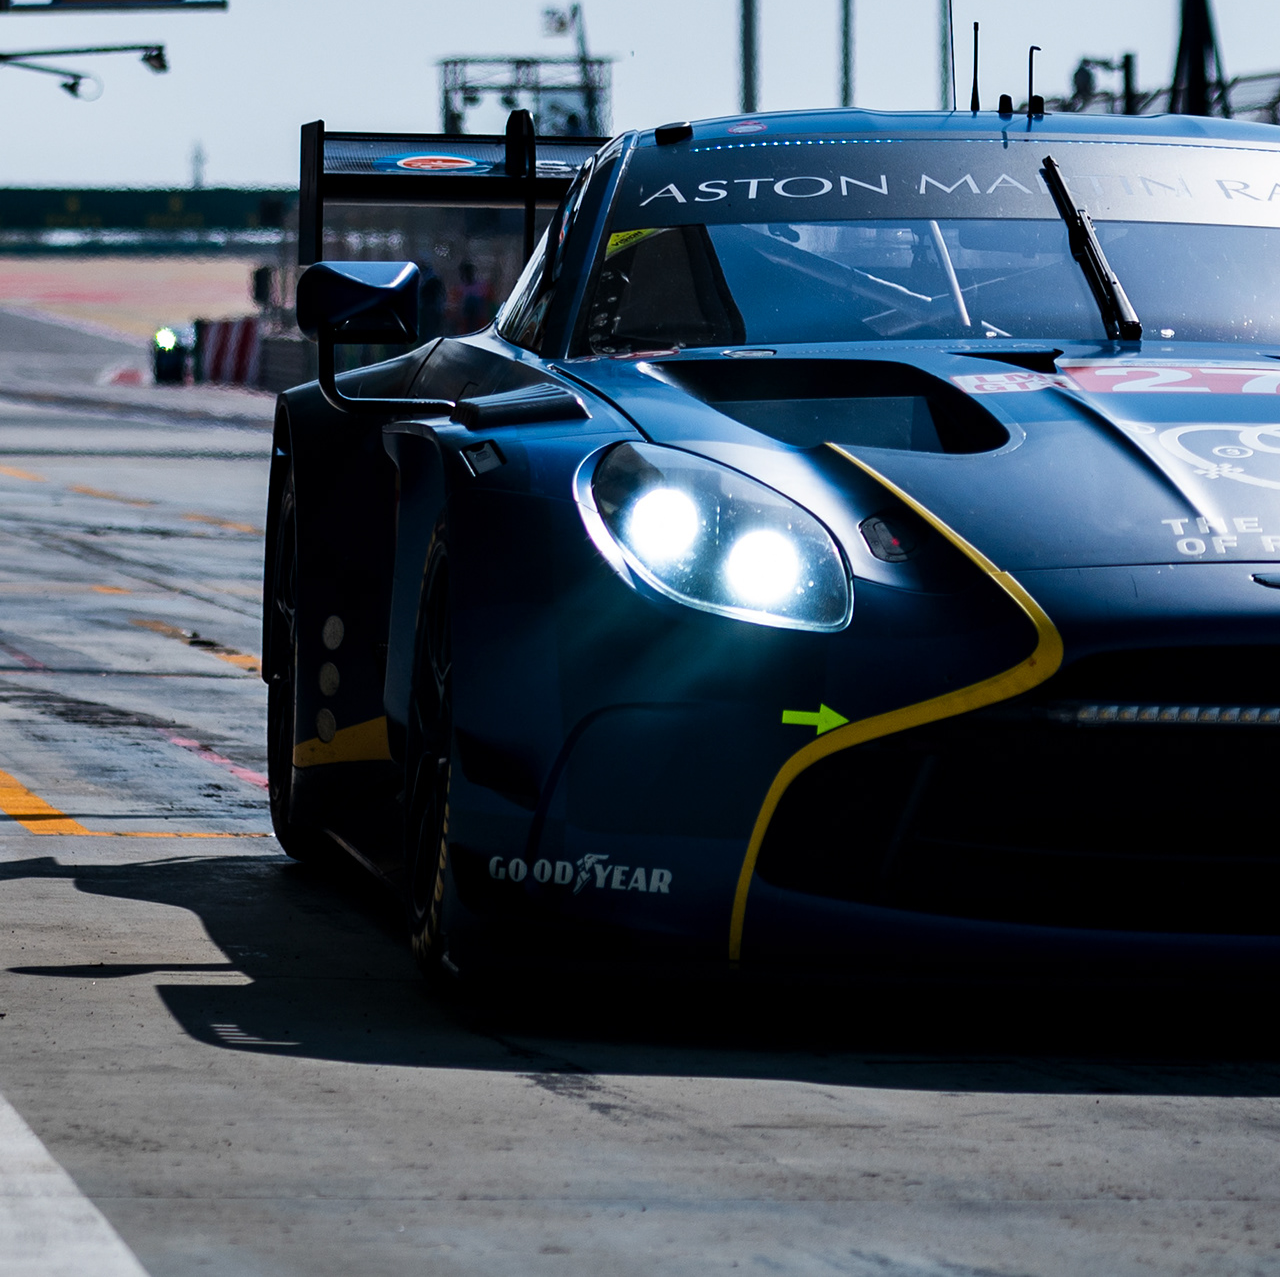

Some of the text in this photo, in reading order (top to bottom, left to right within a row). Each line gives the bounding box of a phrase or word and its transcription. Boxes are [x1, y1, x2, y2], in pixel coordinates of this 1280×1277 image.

[638, 173, 890, 207] ASTON
[1161, 516, 1263, 536] THE
[1176, 535, 1238, 556] OF
[488, 853, 673, 895] GOODYEAR
